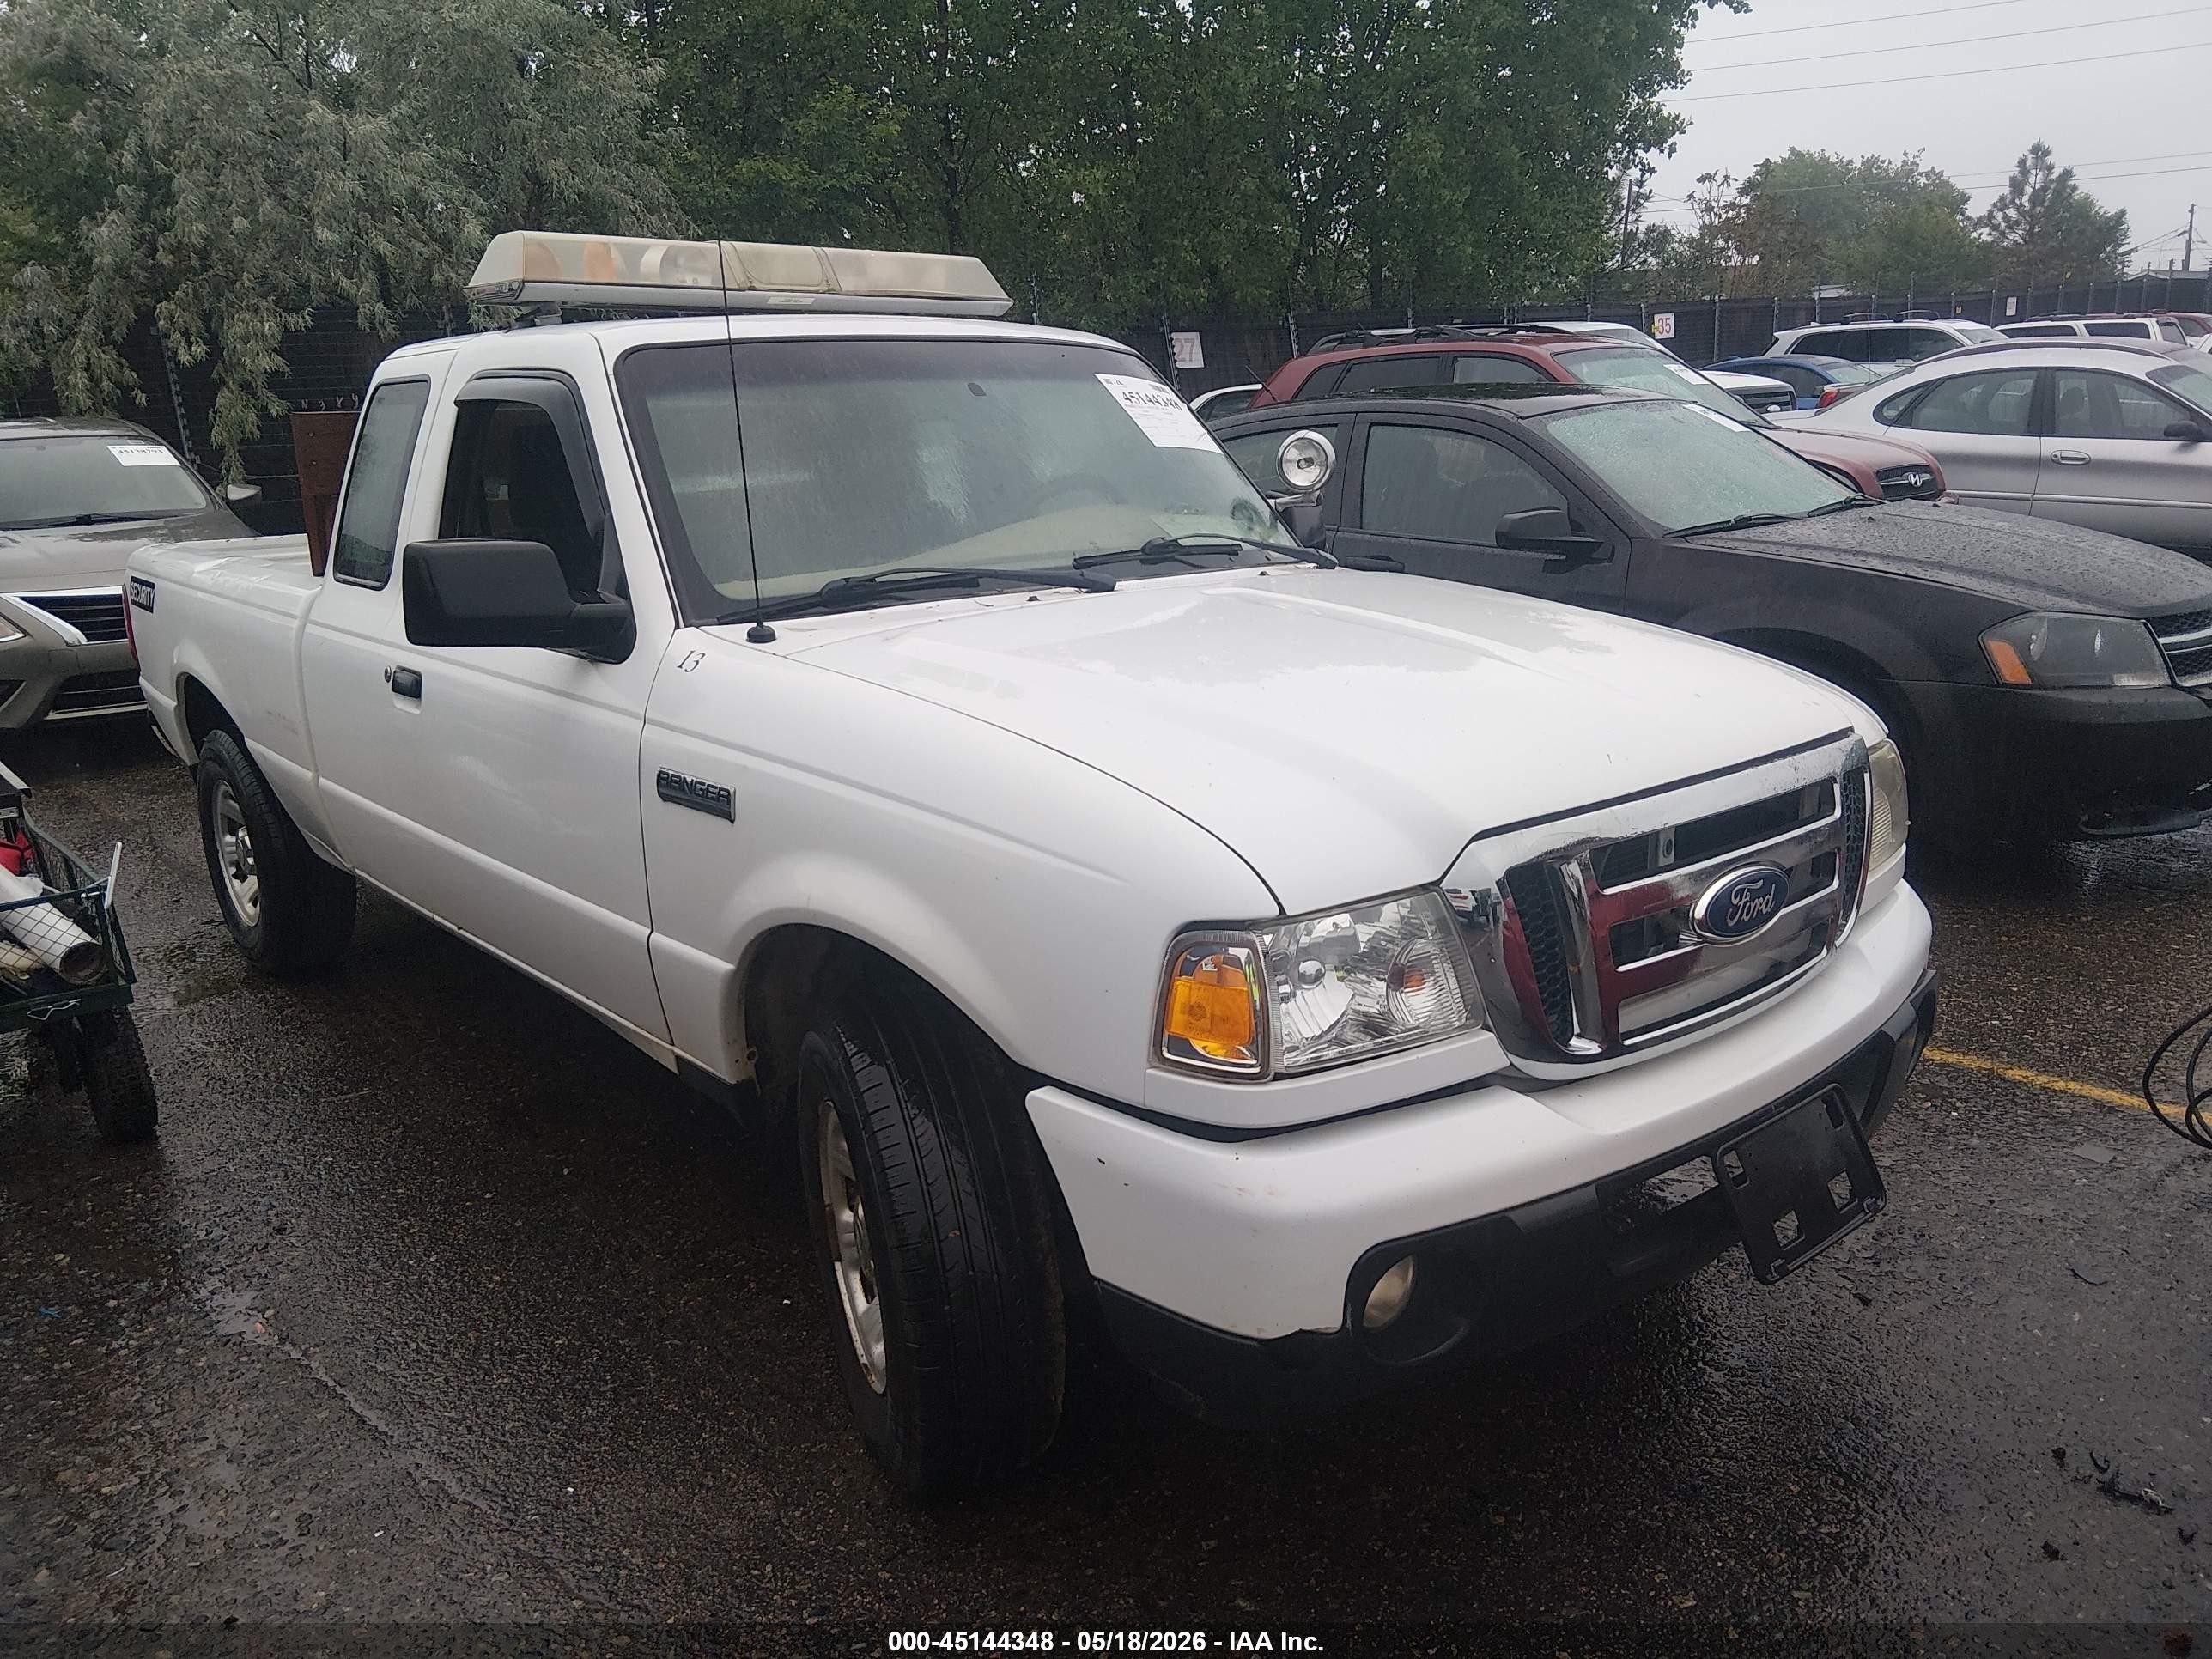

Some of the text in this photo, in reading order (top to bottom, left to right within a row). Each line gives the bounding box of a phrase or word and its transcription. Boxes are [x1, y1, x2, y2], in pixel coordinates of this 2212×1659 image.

[1657, 317, 1672, 335] 35
[1174, 337, 1195, 362] 27
[131, 581, 155, 607] SECURITY
[677, 649, 707, 673] 13
[657, 770, 731, 805] RANGER
[1726, 879, 1776, 927] Ford
